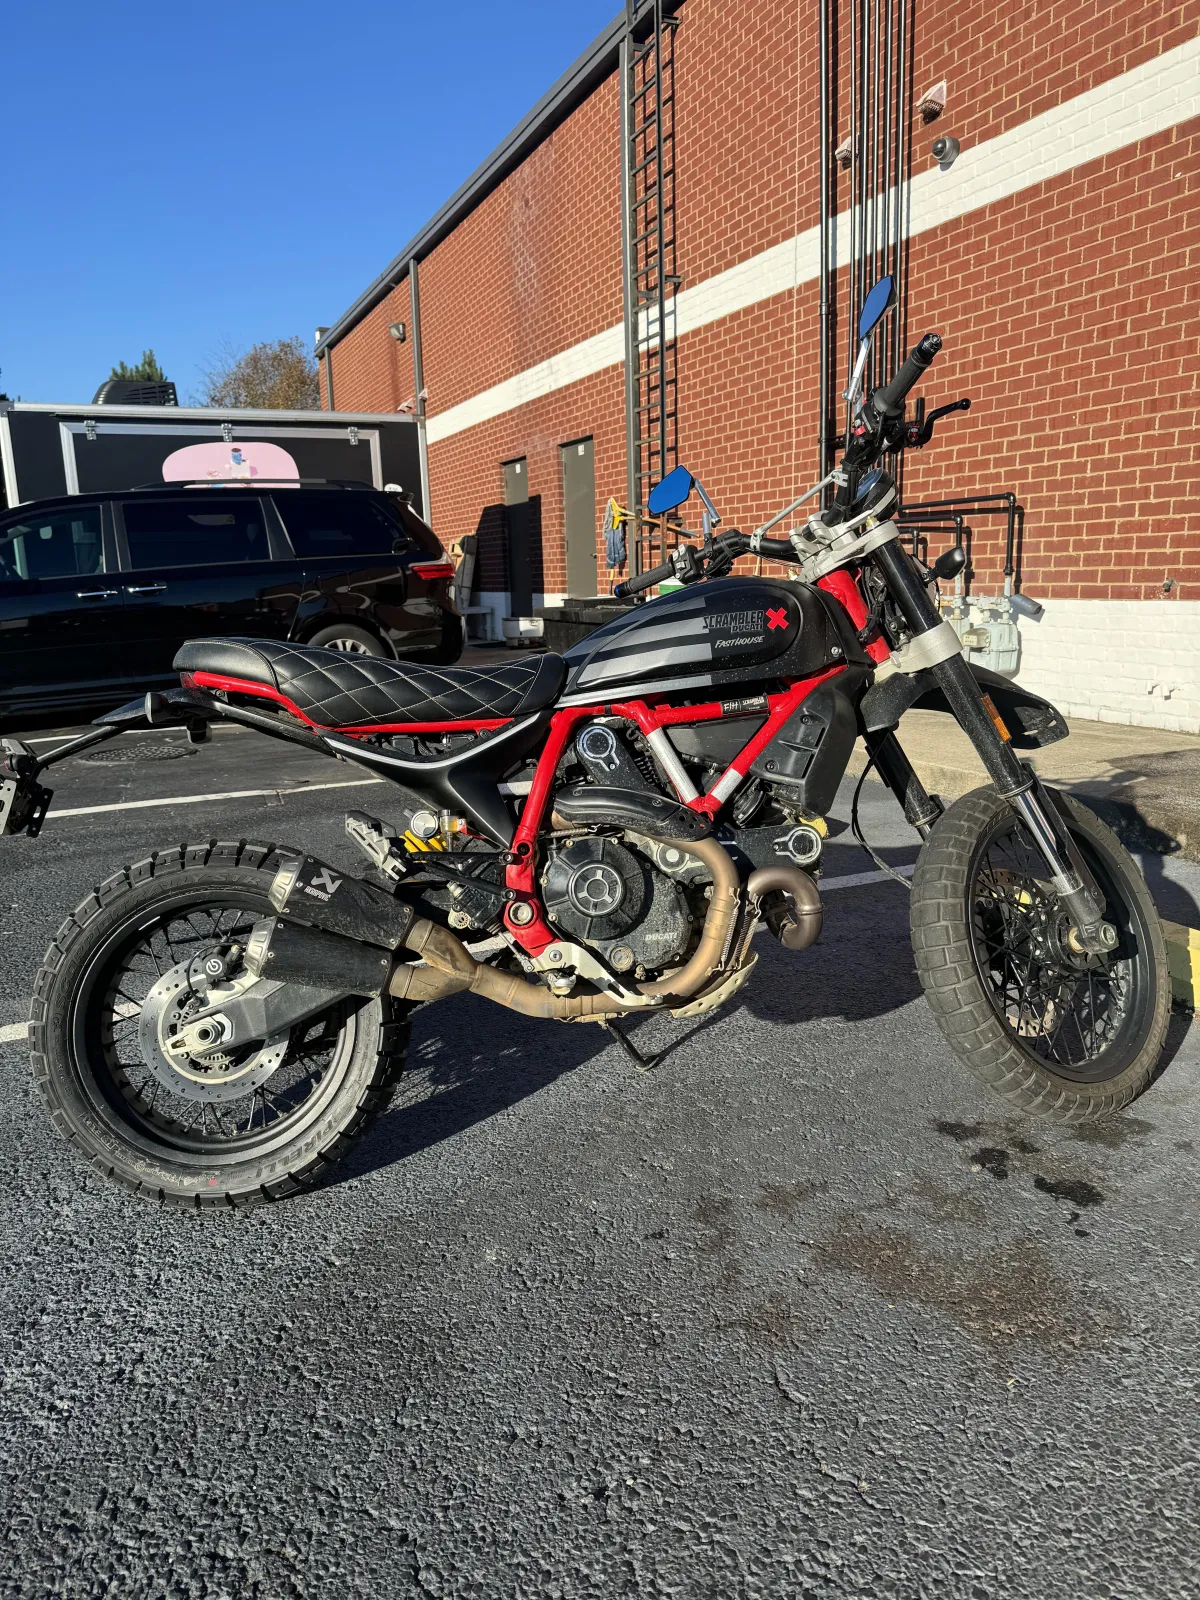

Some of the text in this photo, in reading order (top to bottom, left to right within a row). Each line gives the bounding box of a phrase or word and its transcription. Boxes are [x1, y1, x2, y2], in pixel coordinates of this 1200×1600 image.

[703, 610, 764, 629] SCRAMBLER
[731, 623, 763, 632] DUCATI
[715, 635, 765, 649] FASTHOUSE
[645, 932, 678, 941] DUCATI
[254, 1113, 337, 1179] PIRELLI
